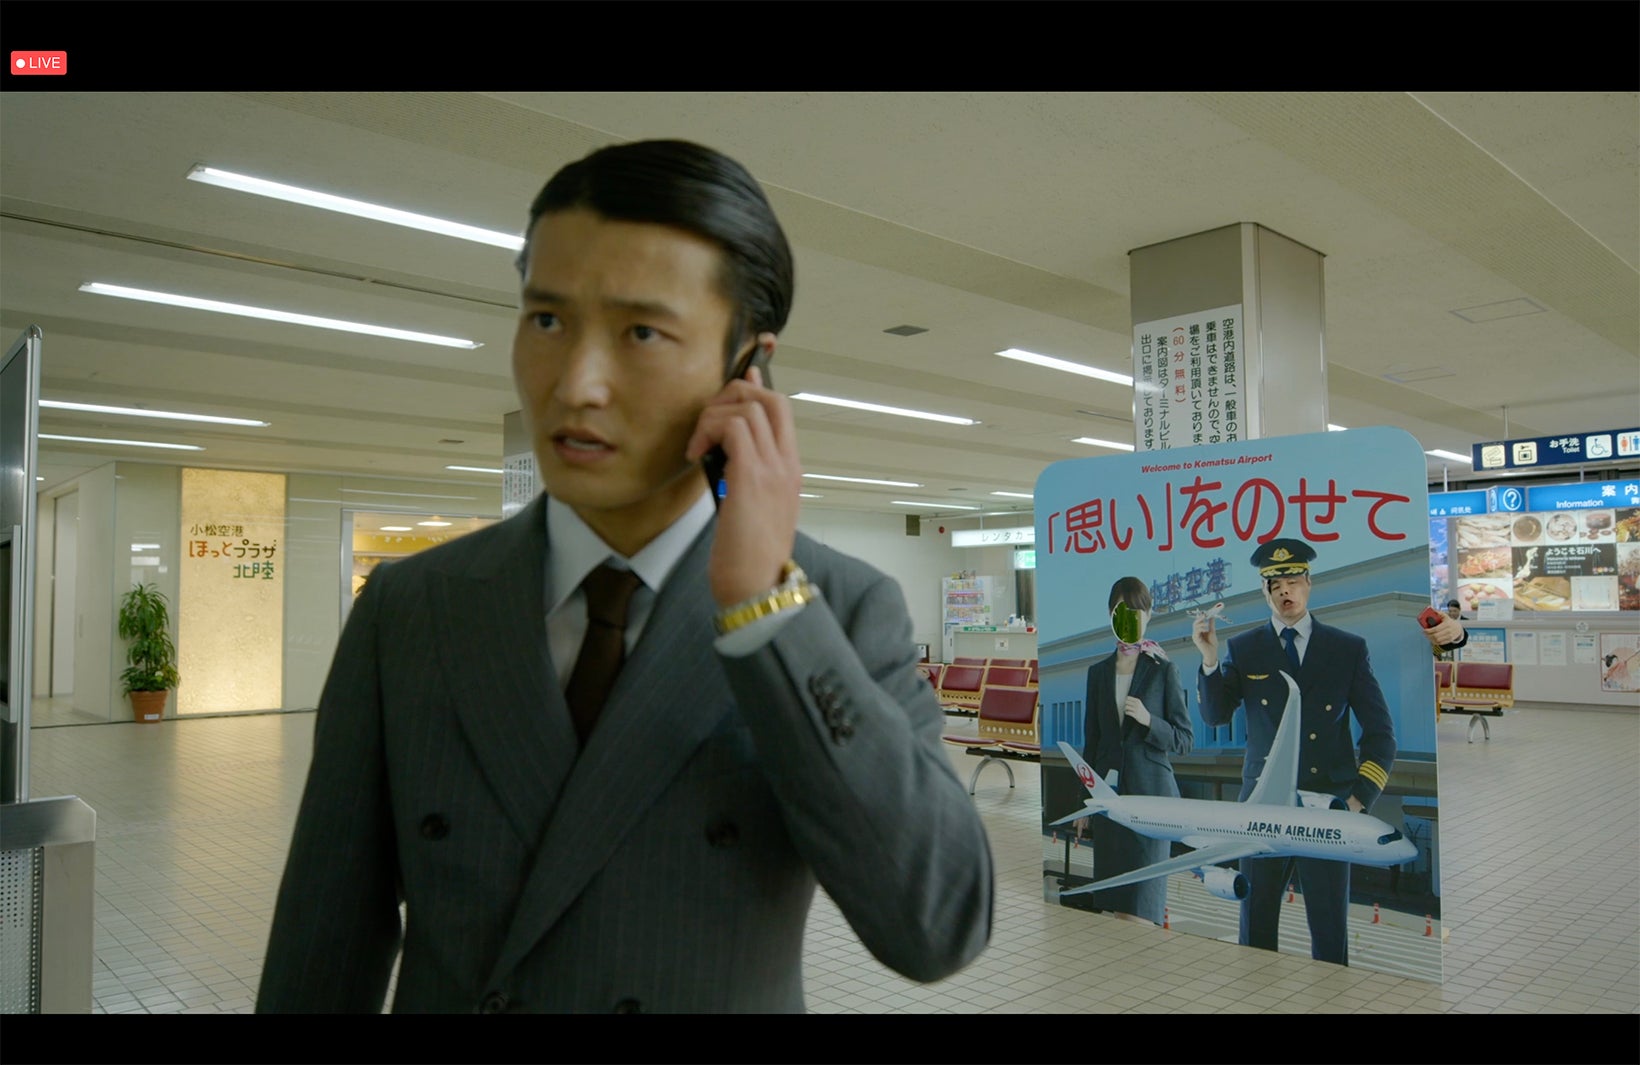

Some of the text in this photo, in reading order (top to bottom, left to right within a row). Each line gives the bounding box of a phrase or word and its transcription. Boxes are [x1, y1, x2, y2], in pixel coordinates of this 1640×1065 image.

[1189, 324, 1203, 446] 場をご利用頂いておりま
[1549, 438, 1580, 449] お手洗
[1141, 453, 1273, 474] Welcome to Komatsu Airport
[1556, 498, 1604, 509] Information
[1047, 475, 1410, 554] 「思い」をのせて
[190, 523, 245, 537] 小松空港
[189, 538, 277, 559] ほっとプラザ
[1546, 546, 1602, 556] ようこそ石川へ
[233, 560, 275, 580] 北陸
[1247, 821, 1342, 840] JAPAN AIRLINES
